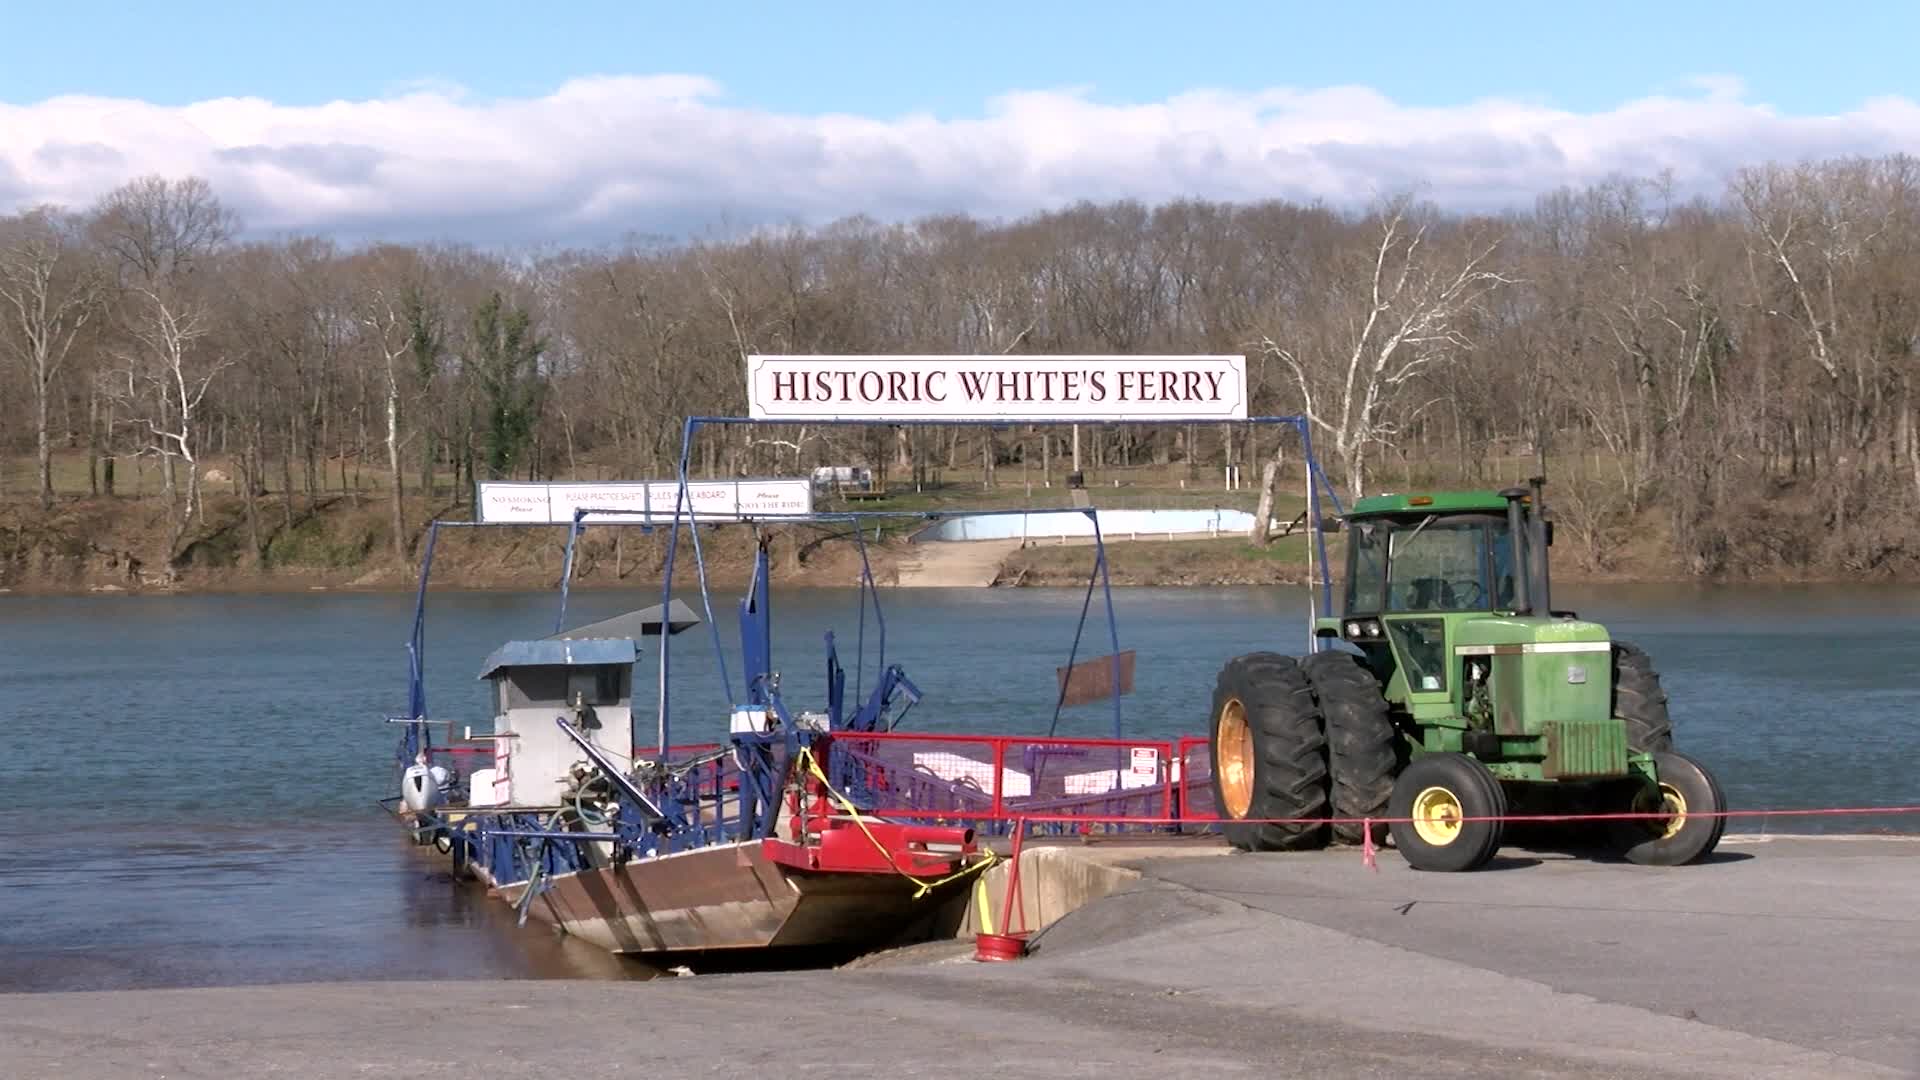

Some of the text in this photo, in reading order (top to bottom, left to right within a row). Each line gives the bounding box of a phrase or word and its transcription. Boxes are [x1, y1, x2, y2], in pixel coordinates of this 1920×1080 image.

[772, 371, 1226, 401] HISTORIC WHITE'S FERRY
[491, 495, 506, 504] NO
